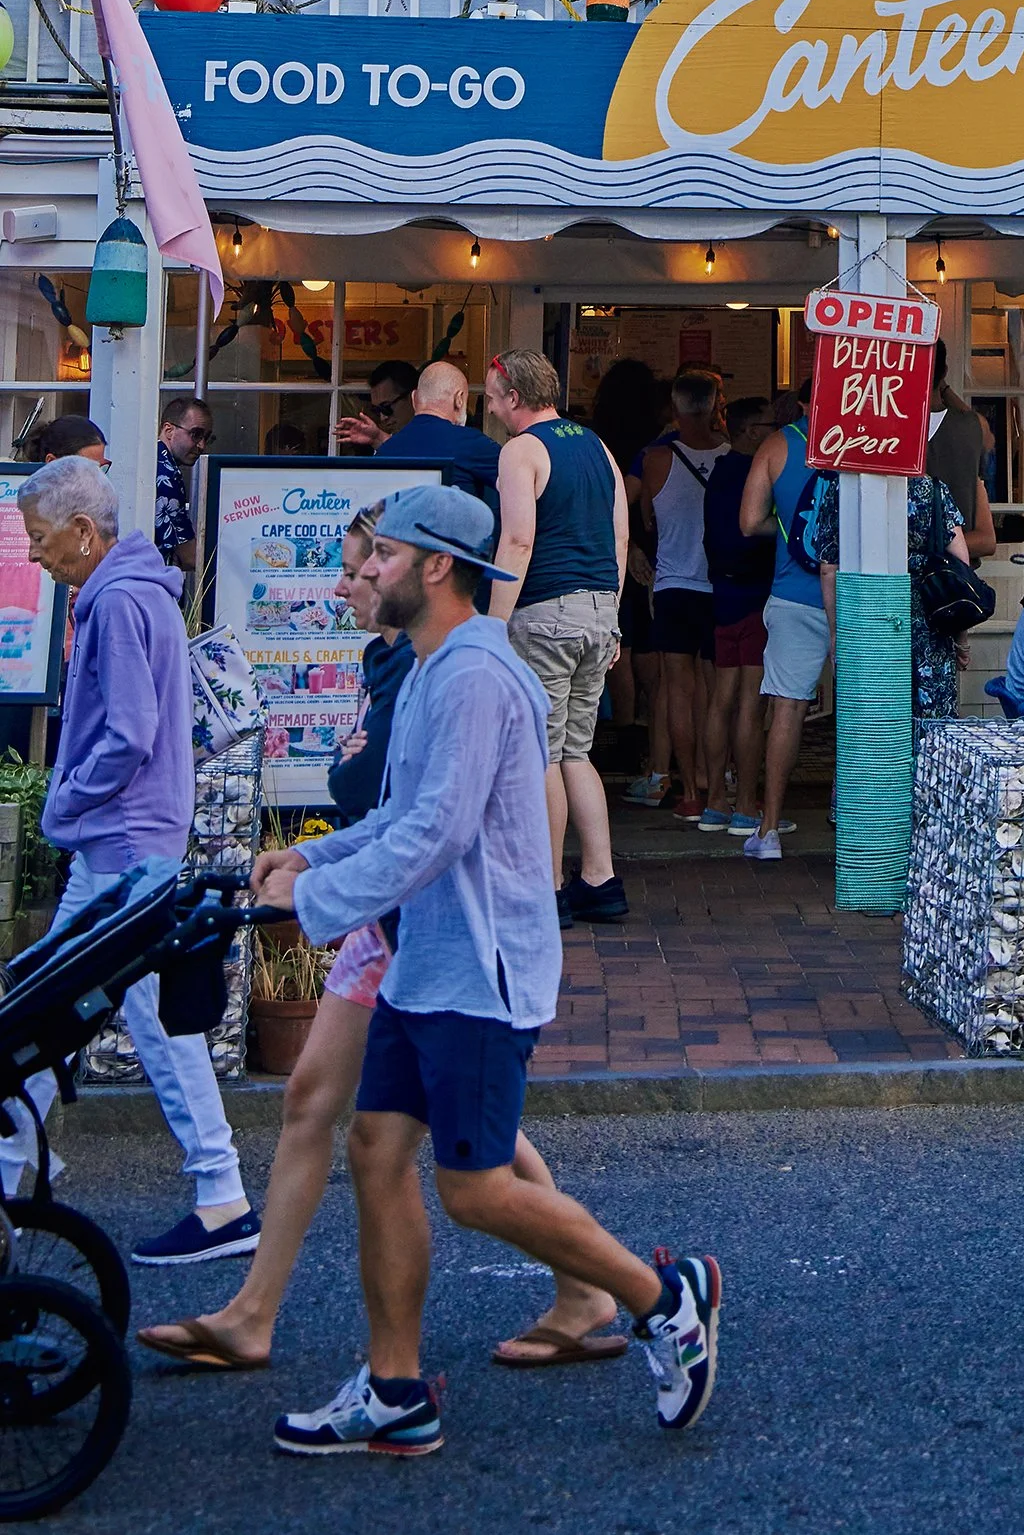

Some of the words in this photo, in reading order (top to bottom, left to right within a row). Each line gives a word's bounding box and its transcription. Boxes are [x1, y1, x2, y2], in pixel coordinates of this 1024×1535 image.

[204, 60, 345, 104] FOOD
[362, 64, 525, 109] TO-GO
[815, 297, 924, 336] OPEN
[833, 336, 917, 372] BEACH
[841, 372, 909, 419] BAR
[857, 423, 867, 433] is
[820, 425, 901, 467] Open
[233, 495, 261, 510] NOW
[282, 487, 351, 515] Canteen
[262, 525, 292, 537] CAPE
[294, 524, 317, 537] COD
[269, 587, 296, 600] NEW
[303, 650, 312, 663] &
[316, 649, 357, 662] CRAFT
